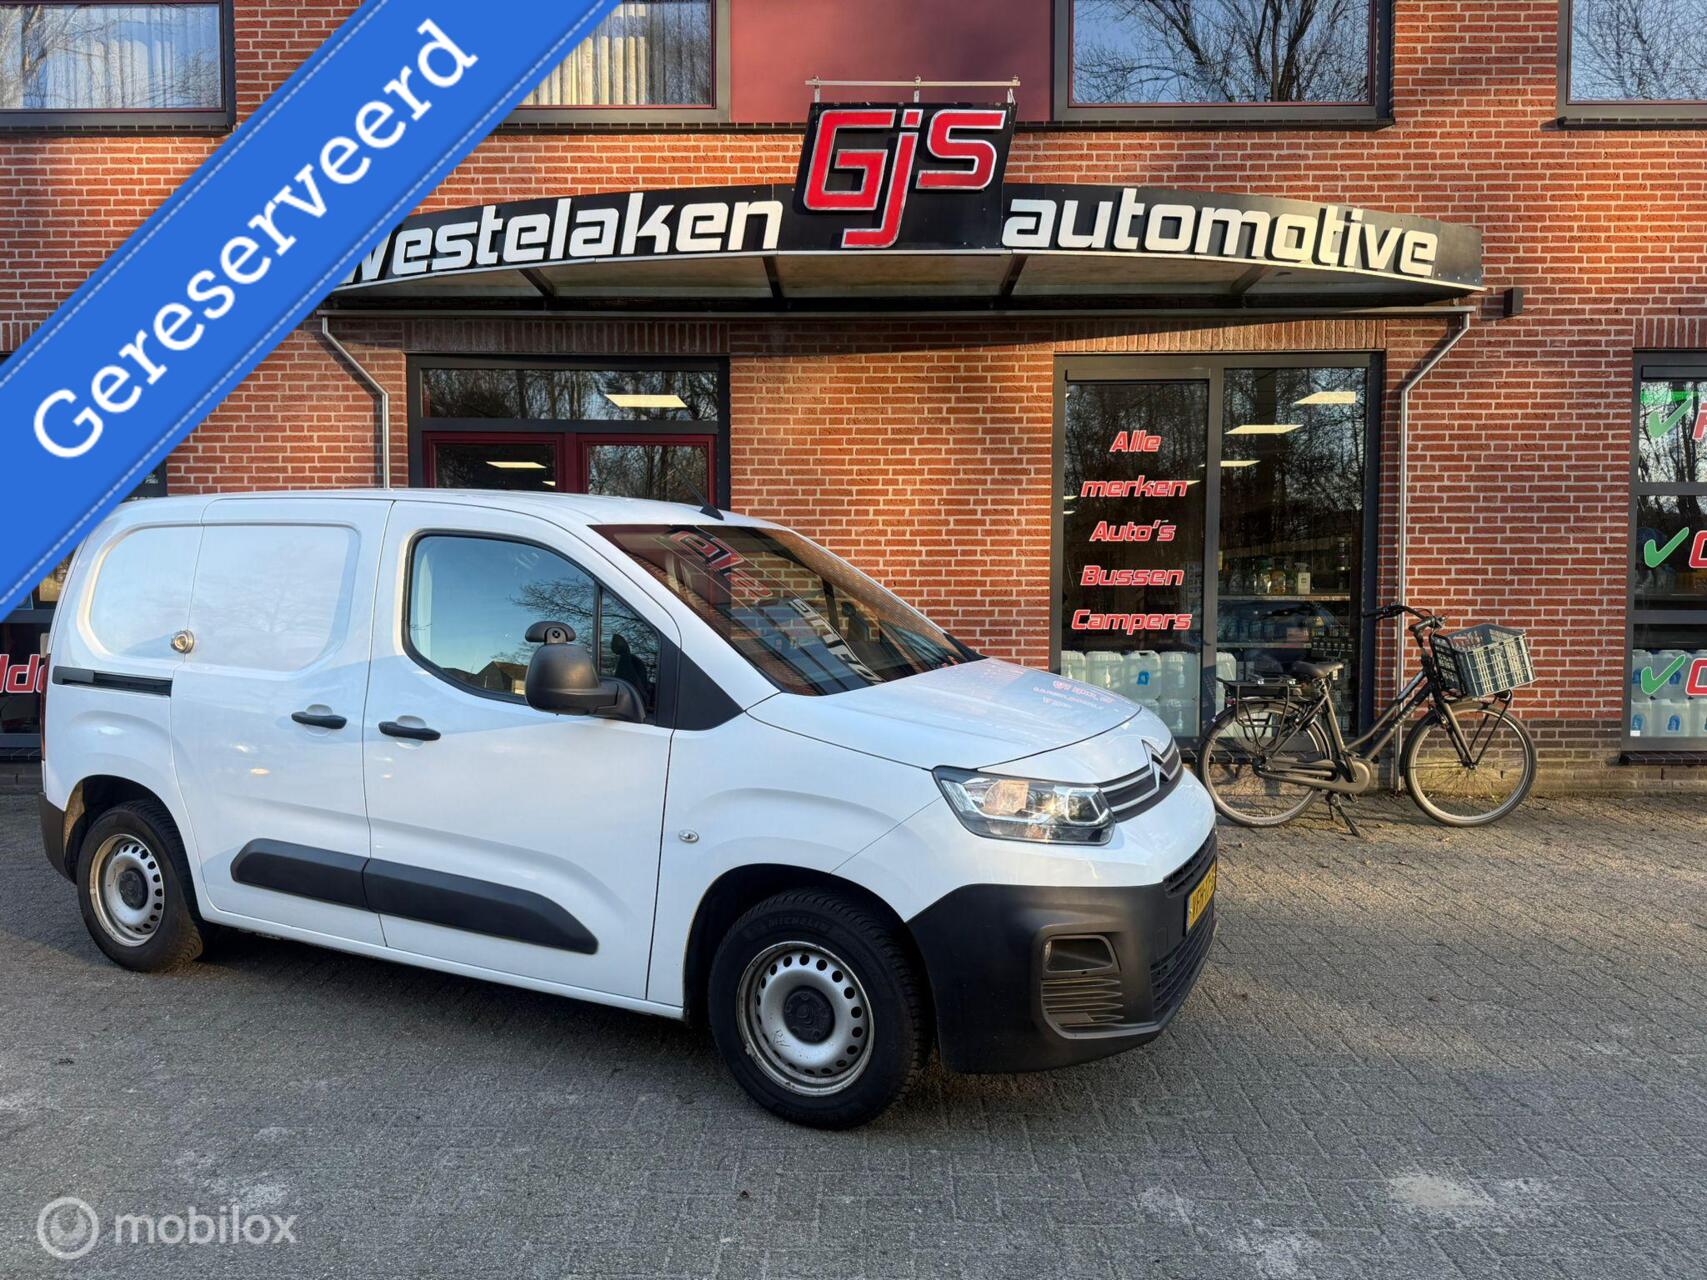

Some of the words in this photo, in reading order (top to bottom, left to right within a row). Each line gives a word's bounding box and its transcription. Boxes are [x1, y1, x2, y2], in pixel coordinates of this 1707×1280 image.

[1002, 188, 1438, 276] automotive
[1109, 430, 1162, 453] Alle
[1080, 475, 1187, 498] merken
[1089, 519, 1176, 542] Auto's
[1080, 564, 1184, 587] Bussen
[1071, 609, 1193, 636] Campers
